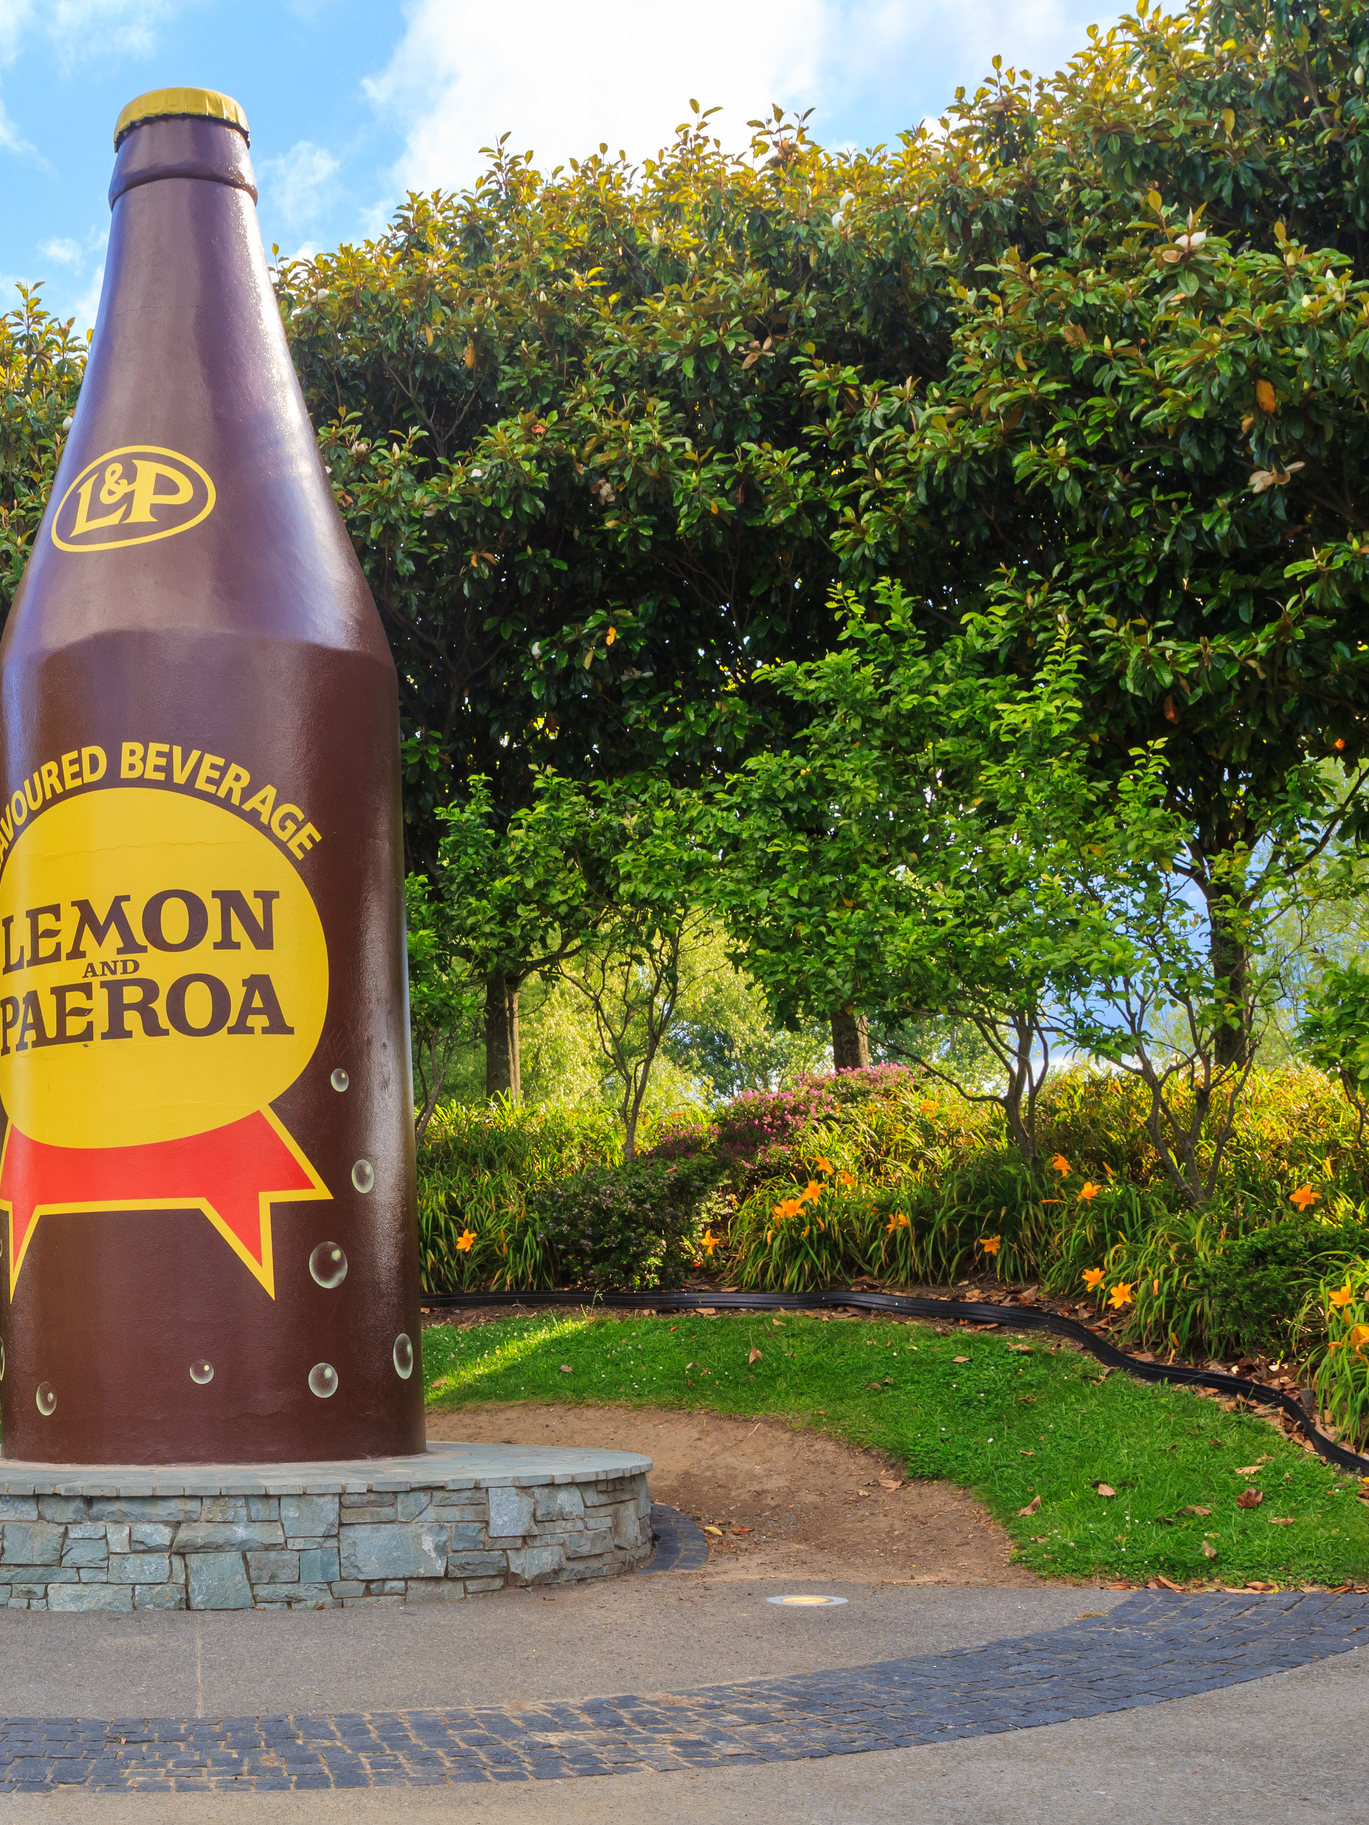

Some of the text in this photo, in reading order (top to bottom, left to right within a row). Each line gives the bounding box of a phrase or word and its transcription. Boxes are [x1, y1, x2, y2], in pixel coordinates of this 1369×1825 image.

[69, 459, 194, 538] L&P
[120, 741, 322, 860] BEVERAGE
[2, 889, 280, 976] LEMON
[81, 959, 140, 978] AND
[0, 973, 295, 1057] PAEROA
